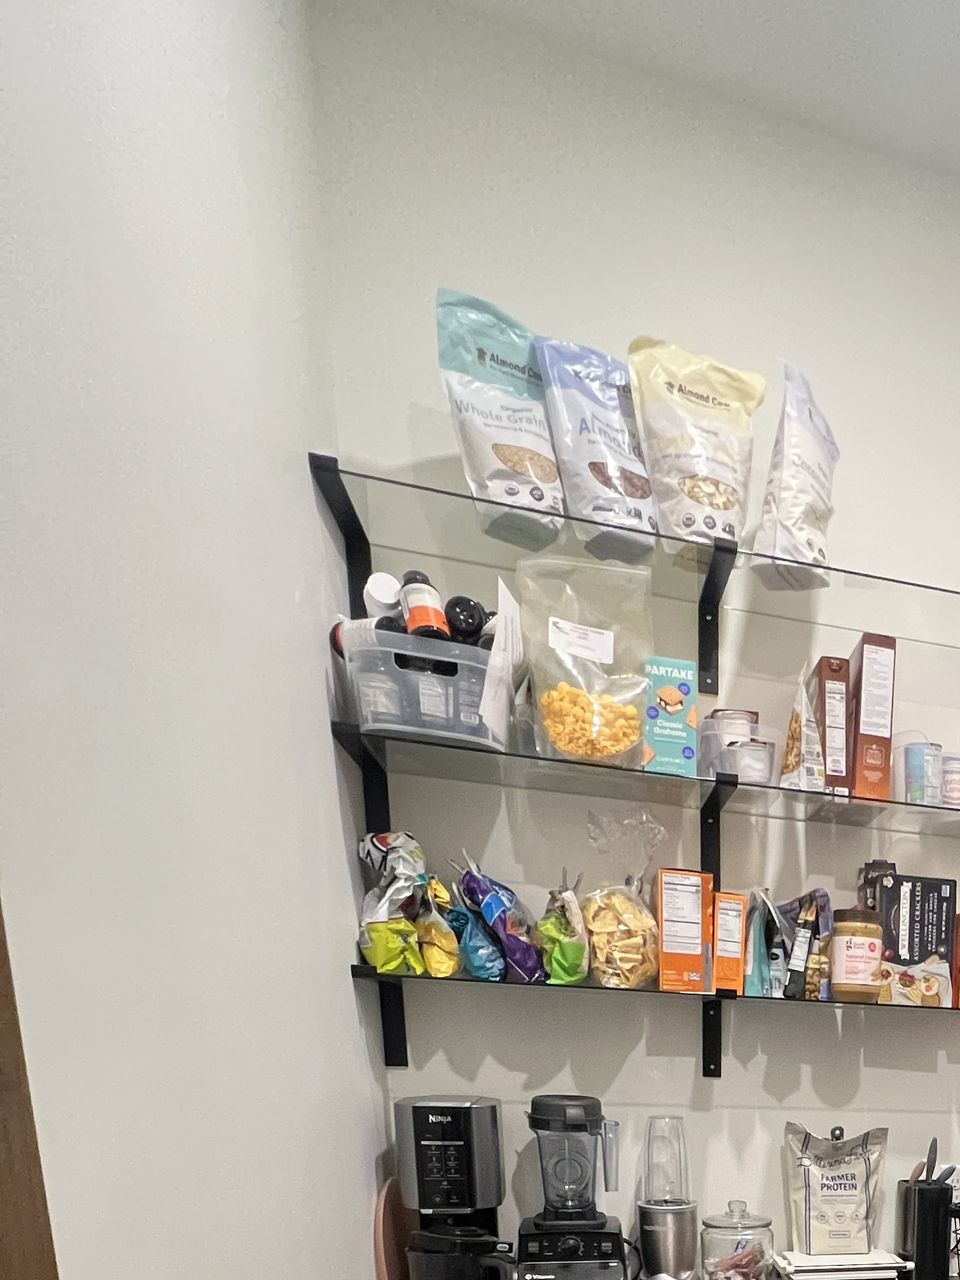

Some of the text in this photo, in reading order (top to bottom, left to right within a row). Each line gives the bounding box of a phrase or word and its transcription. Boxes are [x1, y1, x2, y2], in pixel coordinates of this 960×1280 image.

[489, 353, 526, 375] Almond
[678, 384, 710, 403] Almond
[454, 399, 502, 422] Whole
[507, 414, 547, 432] Grain
[645, 664, 694, 680] PARTAKE
[901, 889, 909, 950] WELLINGTON
[913, 882, 922, 961] ASSORTED CRACKERS
[820, 1172, 857, 1182] FARMER
[820, 1182, 858, 1192] PROTEIN
